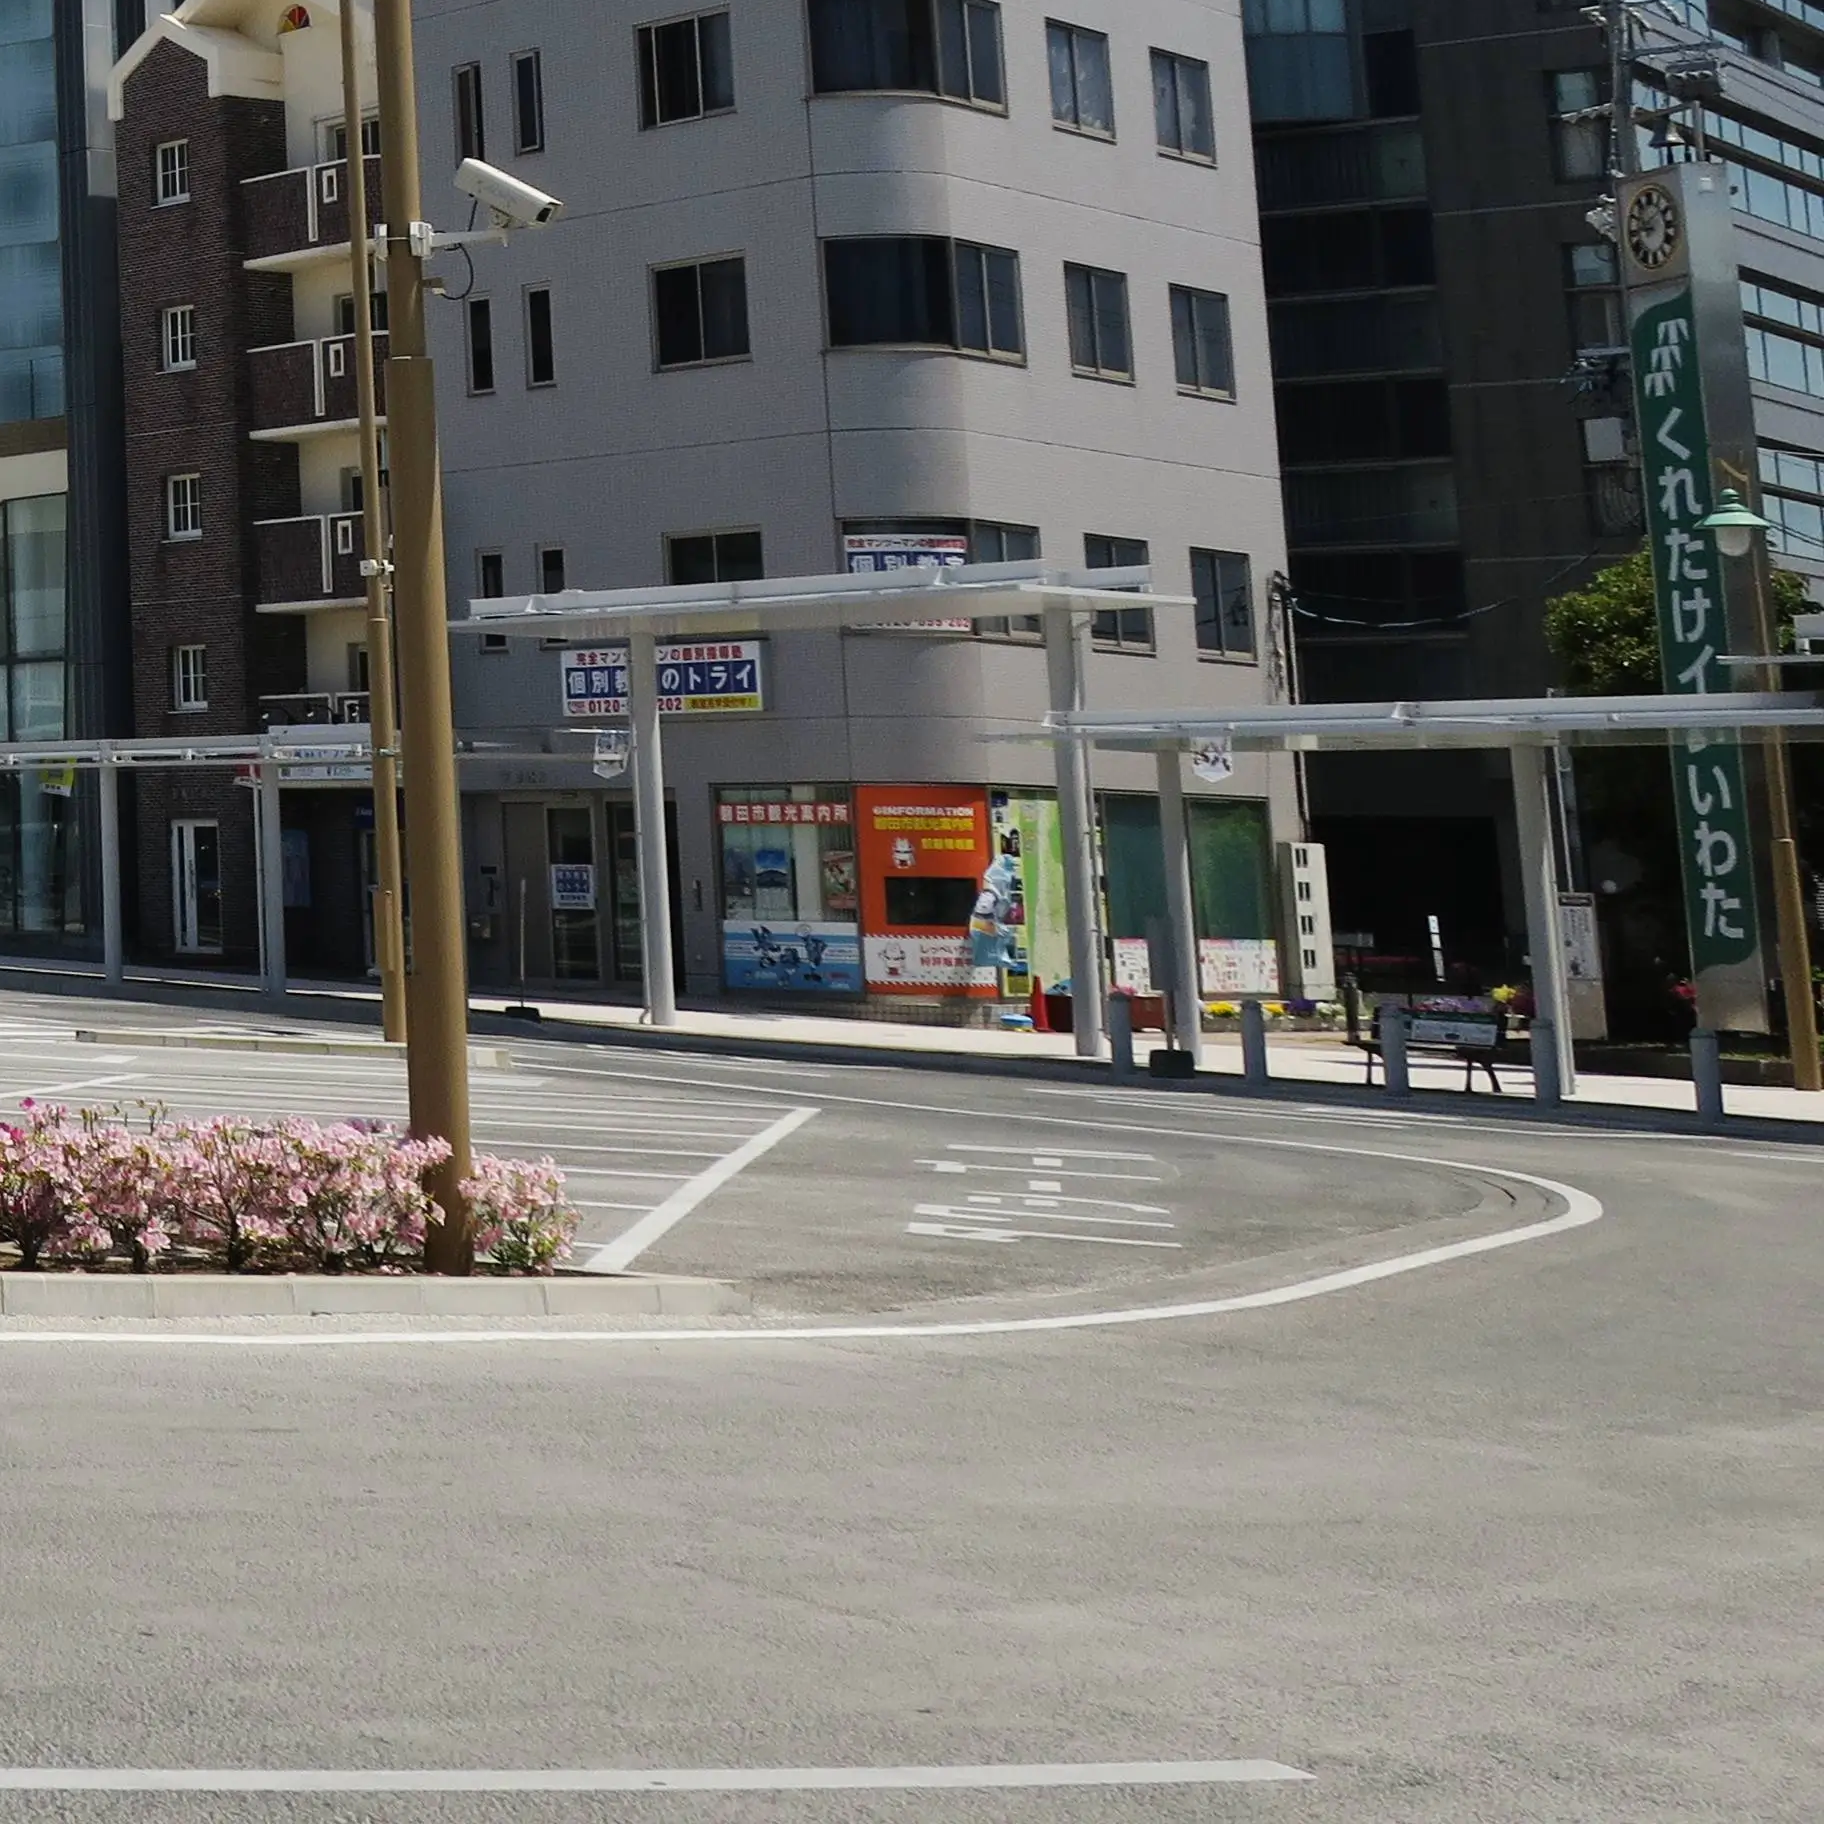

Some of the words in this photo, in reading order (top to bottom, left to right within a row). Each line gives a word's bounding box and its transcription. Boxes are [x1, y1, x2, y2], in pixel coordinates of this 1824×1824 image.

[567, 664, 752, 695] 個別教のトライ
[719, 804, 850, 823] 磐田市観光案内所
